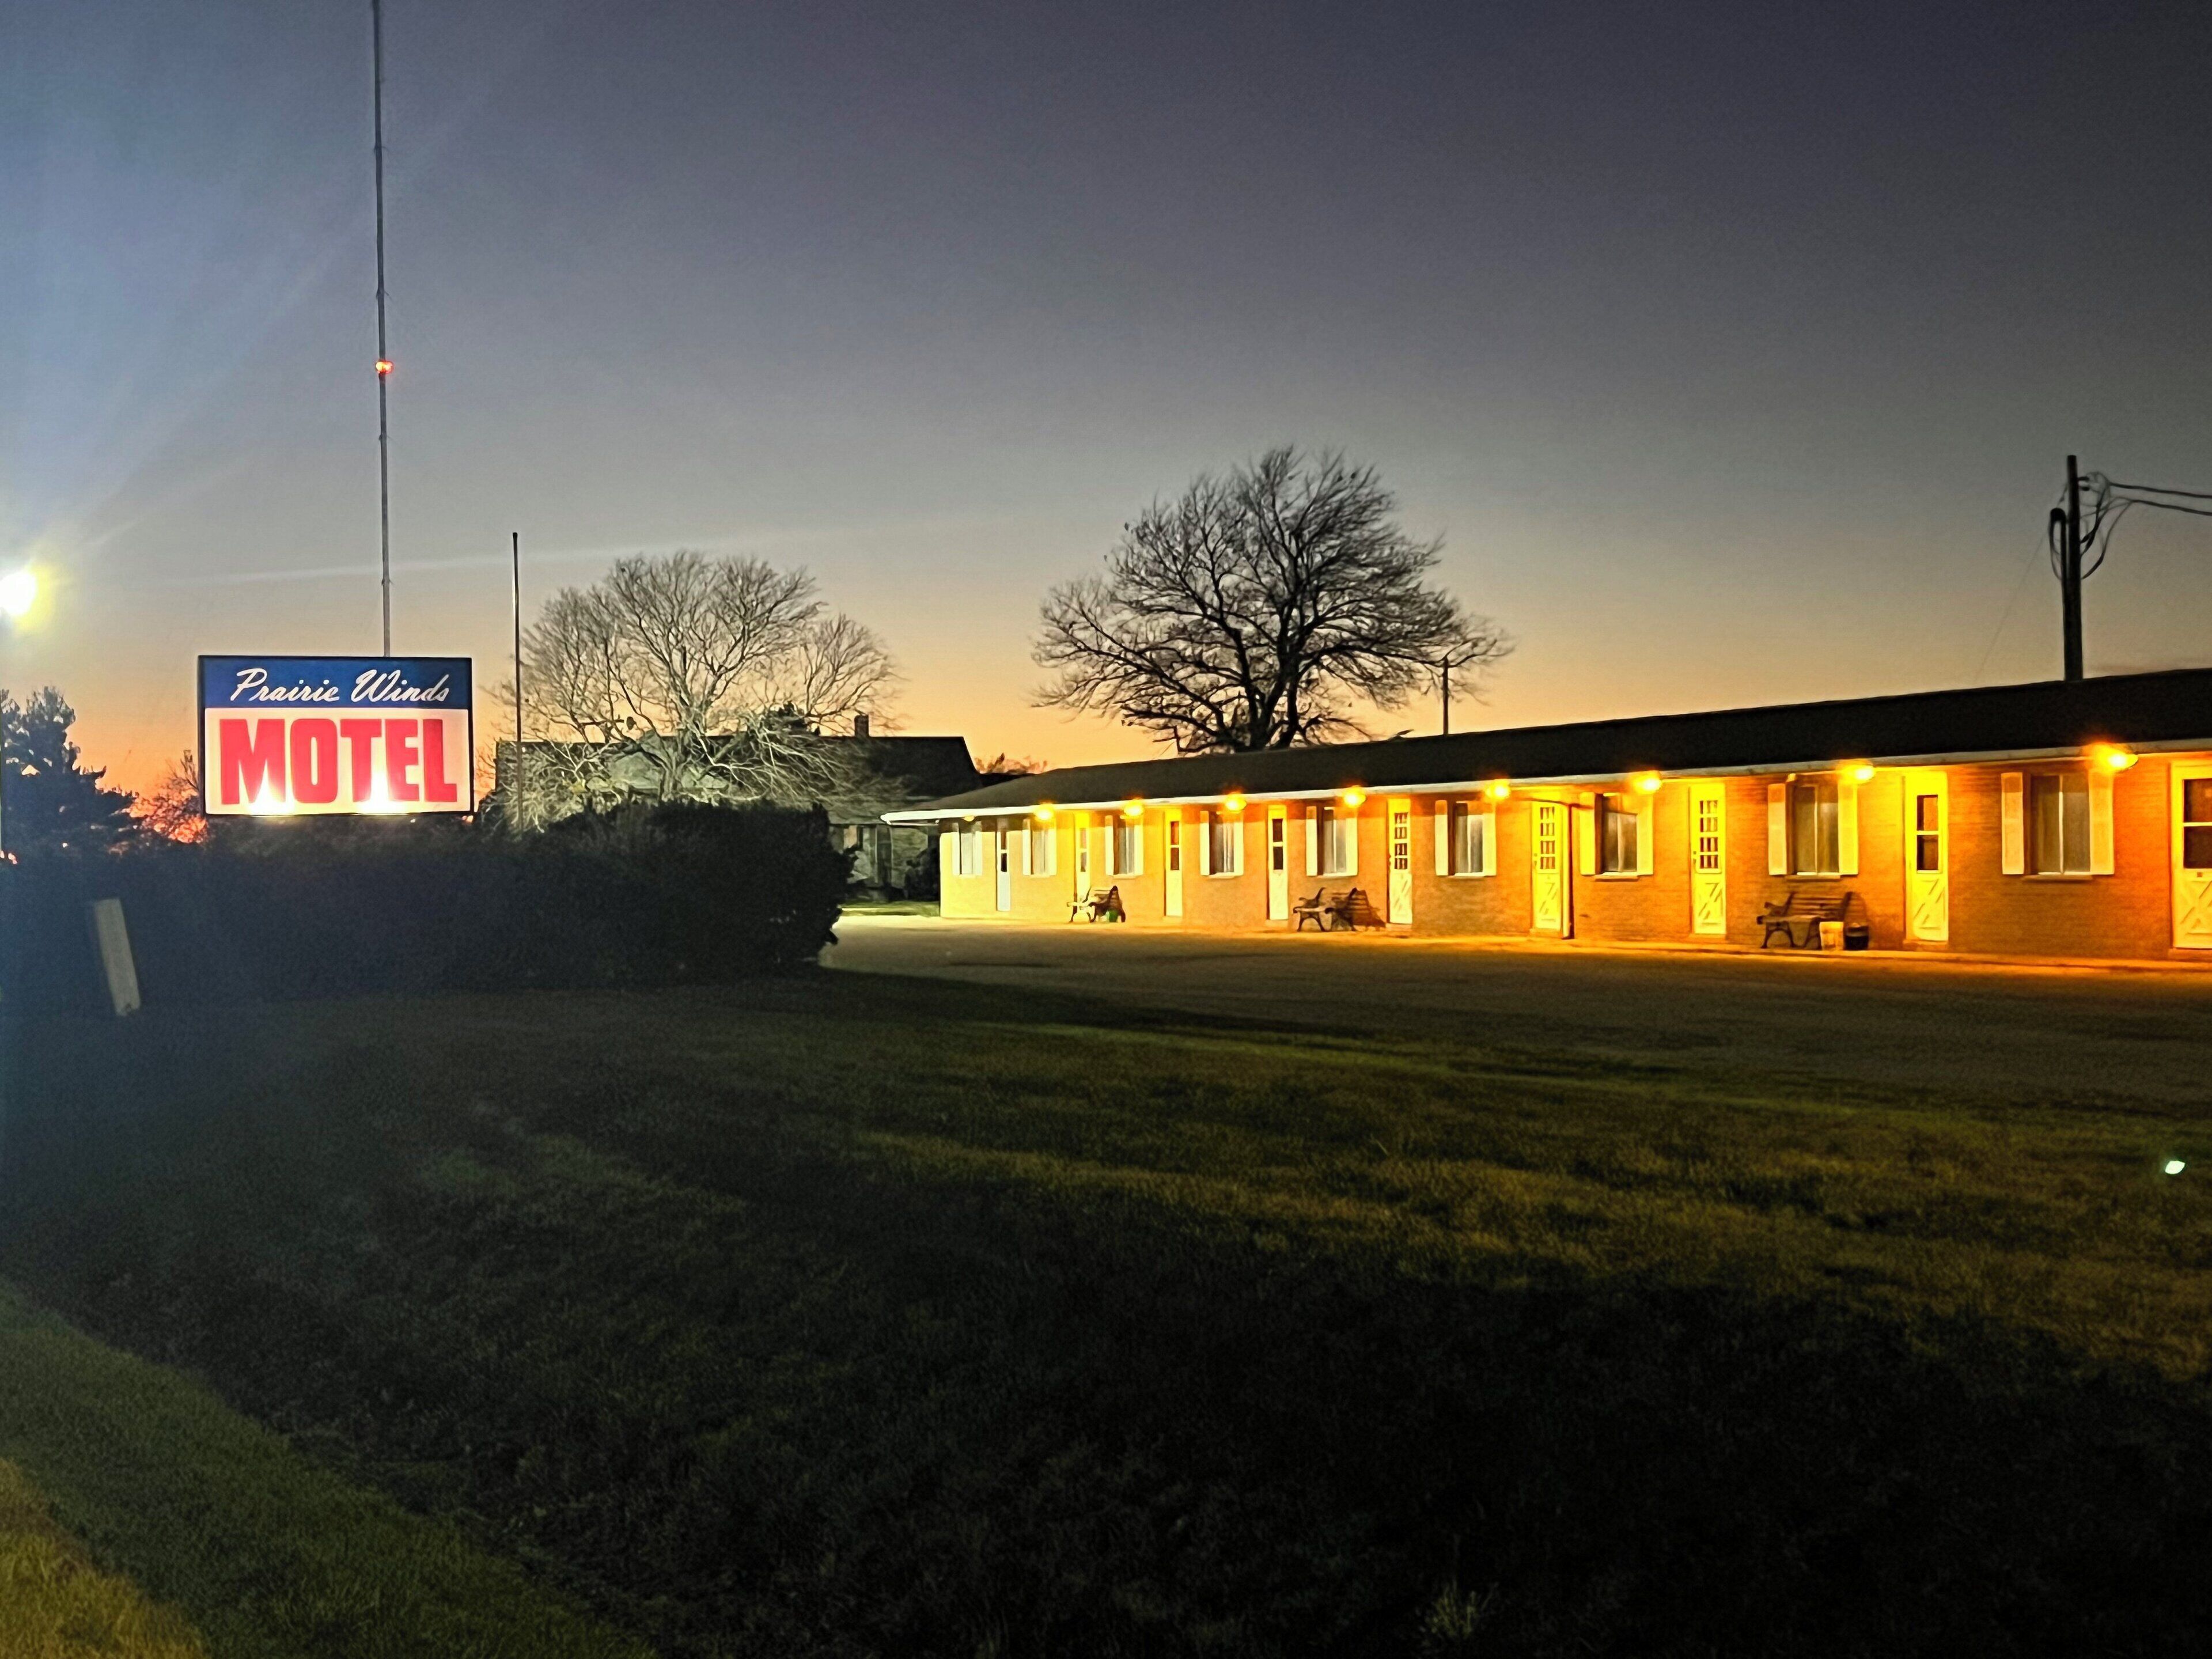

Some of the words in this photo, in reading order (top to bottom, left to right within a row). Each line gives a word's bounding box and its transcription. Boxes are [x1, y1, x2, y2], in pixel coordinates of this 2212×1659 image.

[230, 668, 340, 702] Prairie
[351, 669, 450, 702] Winds
[219, 718, 457, 805] MOTEL
